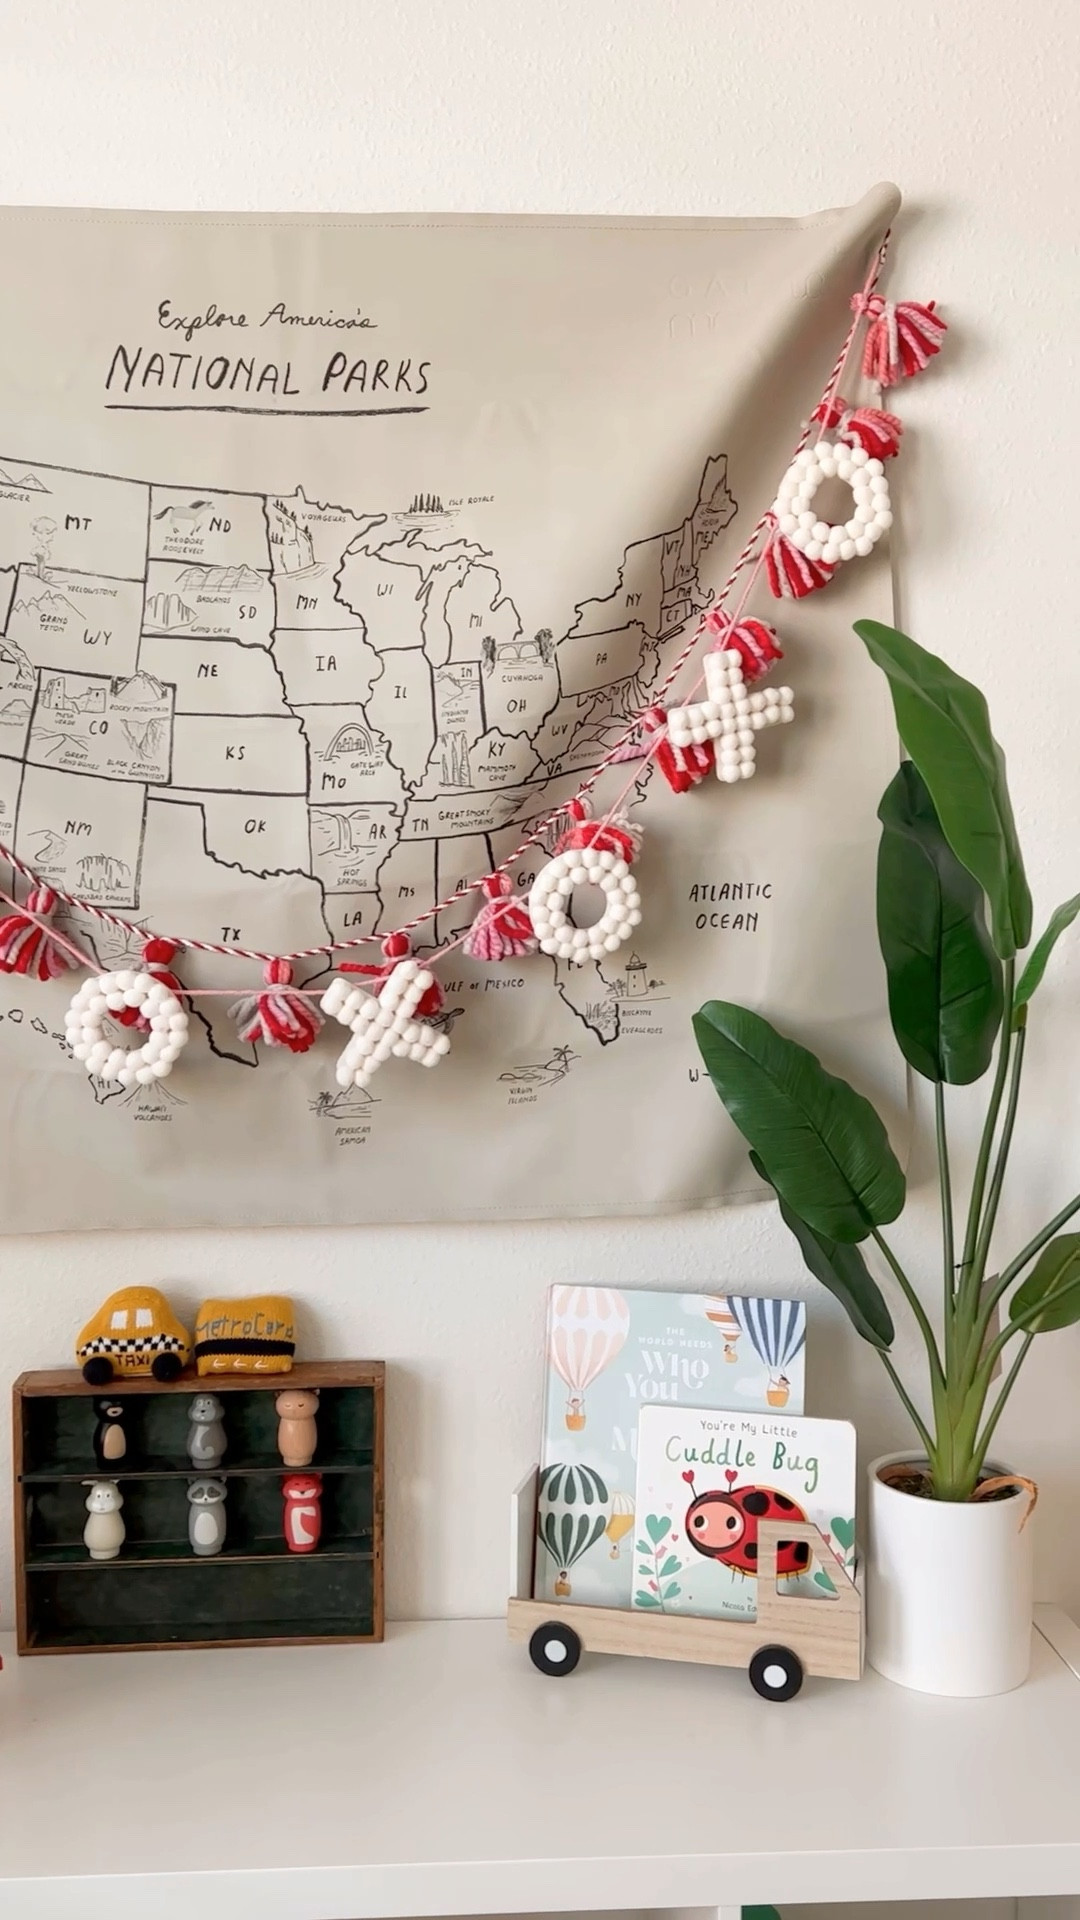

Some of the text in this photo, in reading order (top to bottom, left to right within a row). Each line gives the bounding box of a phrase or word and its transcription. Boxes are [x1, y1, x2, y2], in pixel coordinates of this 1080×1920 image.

[159, 300, 378, 341] Explore America's
[105, 345, 431, 394] NATIONAL PARKS
[65, 514, 92, 530] MT
[301, 512, 347, 523] VOYAGEURS
[209, 517, 231, 533] ND
[165, 536, 204, 545] THEODORE
[695, 531, 710, 545] ME
[666, 540, 680, 556] VT
[67, 585, 119, 597] YELLOWSTONE
[377, 584, 394, 597] WI
[677, 586, 693, 599] MA
[296, 594, 318, 610] MN
[626, 593, 642, 608] NY
[40, 613, 69, 625] GRAND
[239, 605, 257, 619] SD
[666, 609, 680, 622] CT
[469, 612, 483, 628] MI
[39, 624, 65, 633] TETON
[84, 629, 112, 645] WY
[316, 655, 337, 672] IA
[596, 653, 608, 666] PA
[198, 664, 218, 678] NE
[461, 667, 473, 678] IN
[109, 703, 131, 712] ROCKY
[507, 699, 527, 713] OH
[89, 720, 108, 735] CO
[551, 724, 568, 737] WV
[65, 751, 88, 760] GREAT
[226, 746, 245, 760] KS
[488, 740, 506, 758] KY
[478, 764, 517, 773] MAMMOTH
[547, 763, 563, 777] VA
[438, 810, 464, 821] GREAT
[65, 820, 92, 836] NM
[245, 819, 266, 834] OK
[369, 823, 387, 839] AR
[412, 818, 429, 832] TN
[337, 878, 367, 887] SPRINGS
[517, 872, 535, 886] GA
[689, 883, 773, 902] ATLANTIC
[344, 911, 362, 927] LA
[696, 912, 759, 932] OCEAN
[221, 927, 241, 941] TX
[444, 980, 464, 993] ULF
[484, 978, 525, 991] MEXICO
[97, 1080, 111, 1090] HI
[666, 1327, 685, 1337] THE
[638, 1336, 713, 1349] WORLD NEEDS
[115, 1354, 150, 1367] TAXI
[641, 1350, 709, 1389] Who
[625, 1373, 678, 1401] You
[700, 1420, 797, 1438] You're My Little
[665, 1435, 756, 1468] Cuddle
[773, 1442, 819, 1493] Bug
